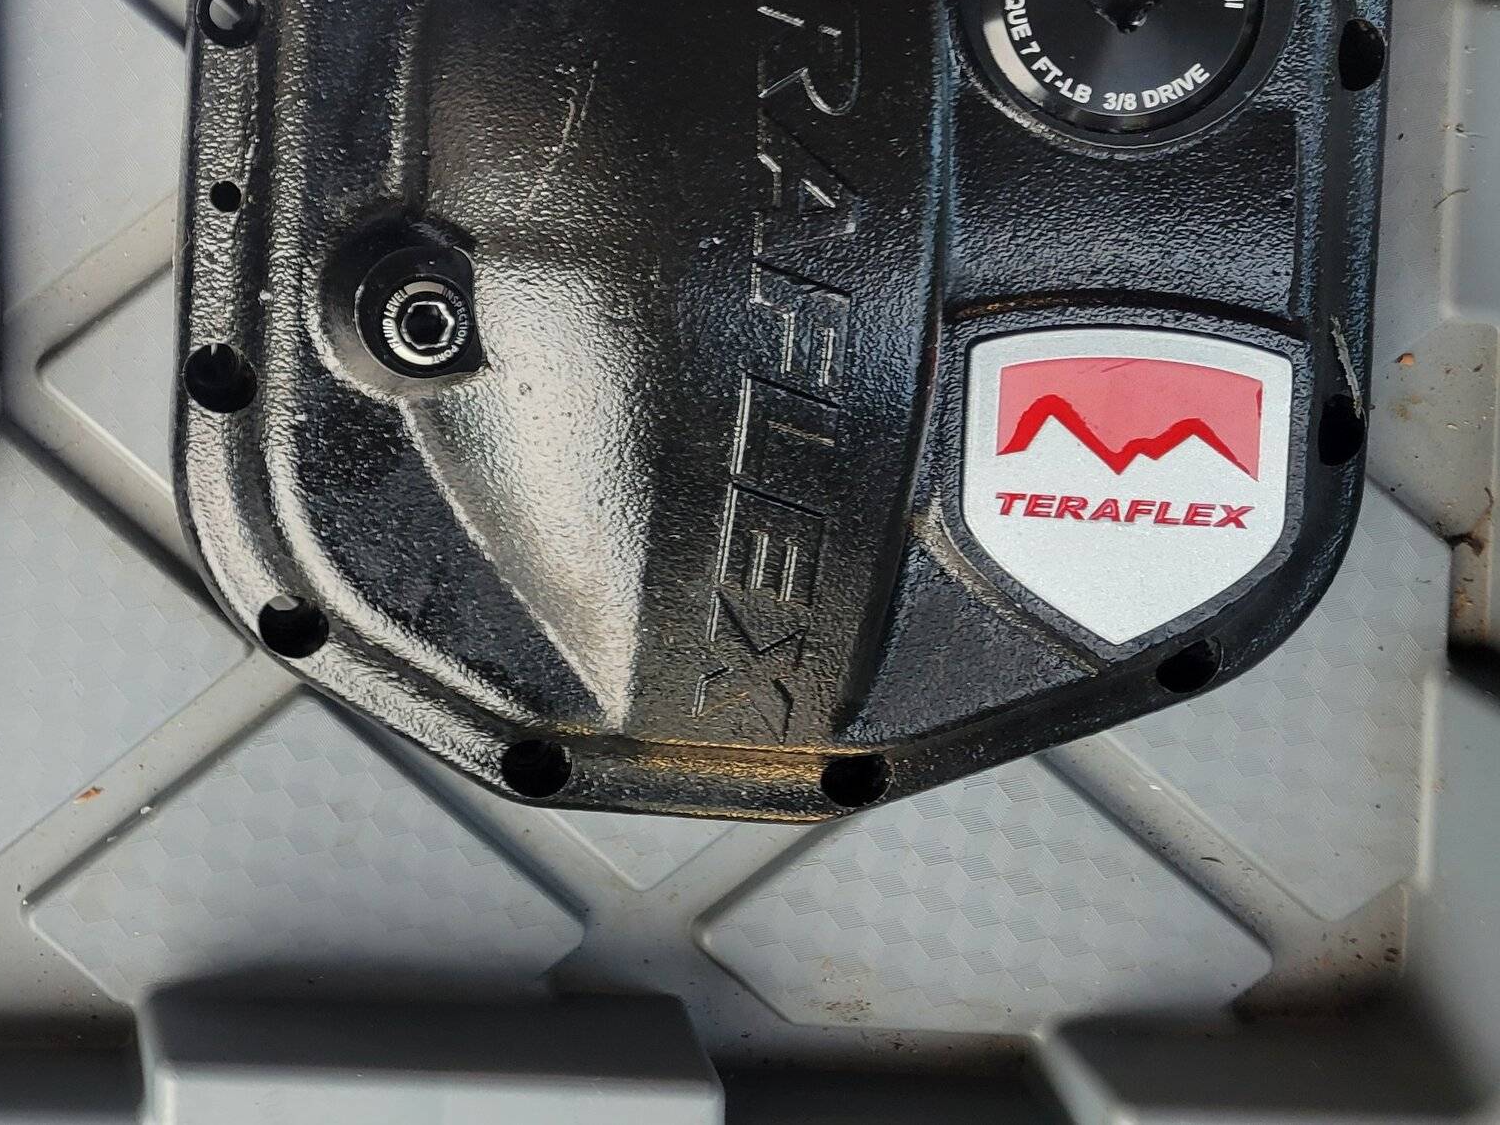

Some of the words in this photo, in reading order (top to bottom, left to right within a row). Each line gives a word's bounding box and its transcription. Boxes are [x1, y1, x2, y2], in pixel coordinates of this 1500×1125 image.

[1020, 41, 1041, 56] 7
[1031, 55, 1092, 104] FT-LB
[1102, 92, 1137, 111] 3/8
[1141, 63, 1210, 109] DRIVE
[383, 289, 408, 318] LEVEL
[442, 287, 469, 345] INSPECTION
[431, 344, 460, 364] PORT
[995, 491, 1255, 529] TERAFLEX
